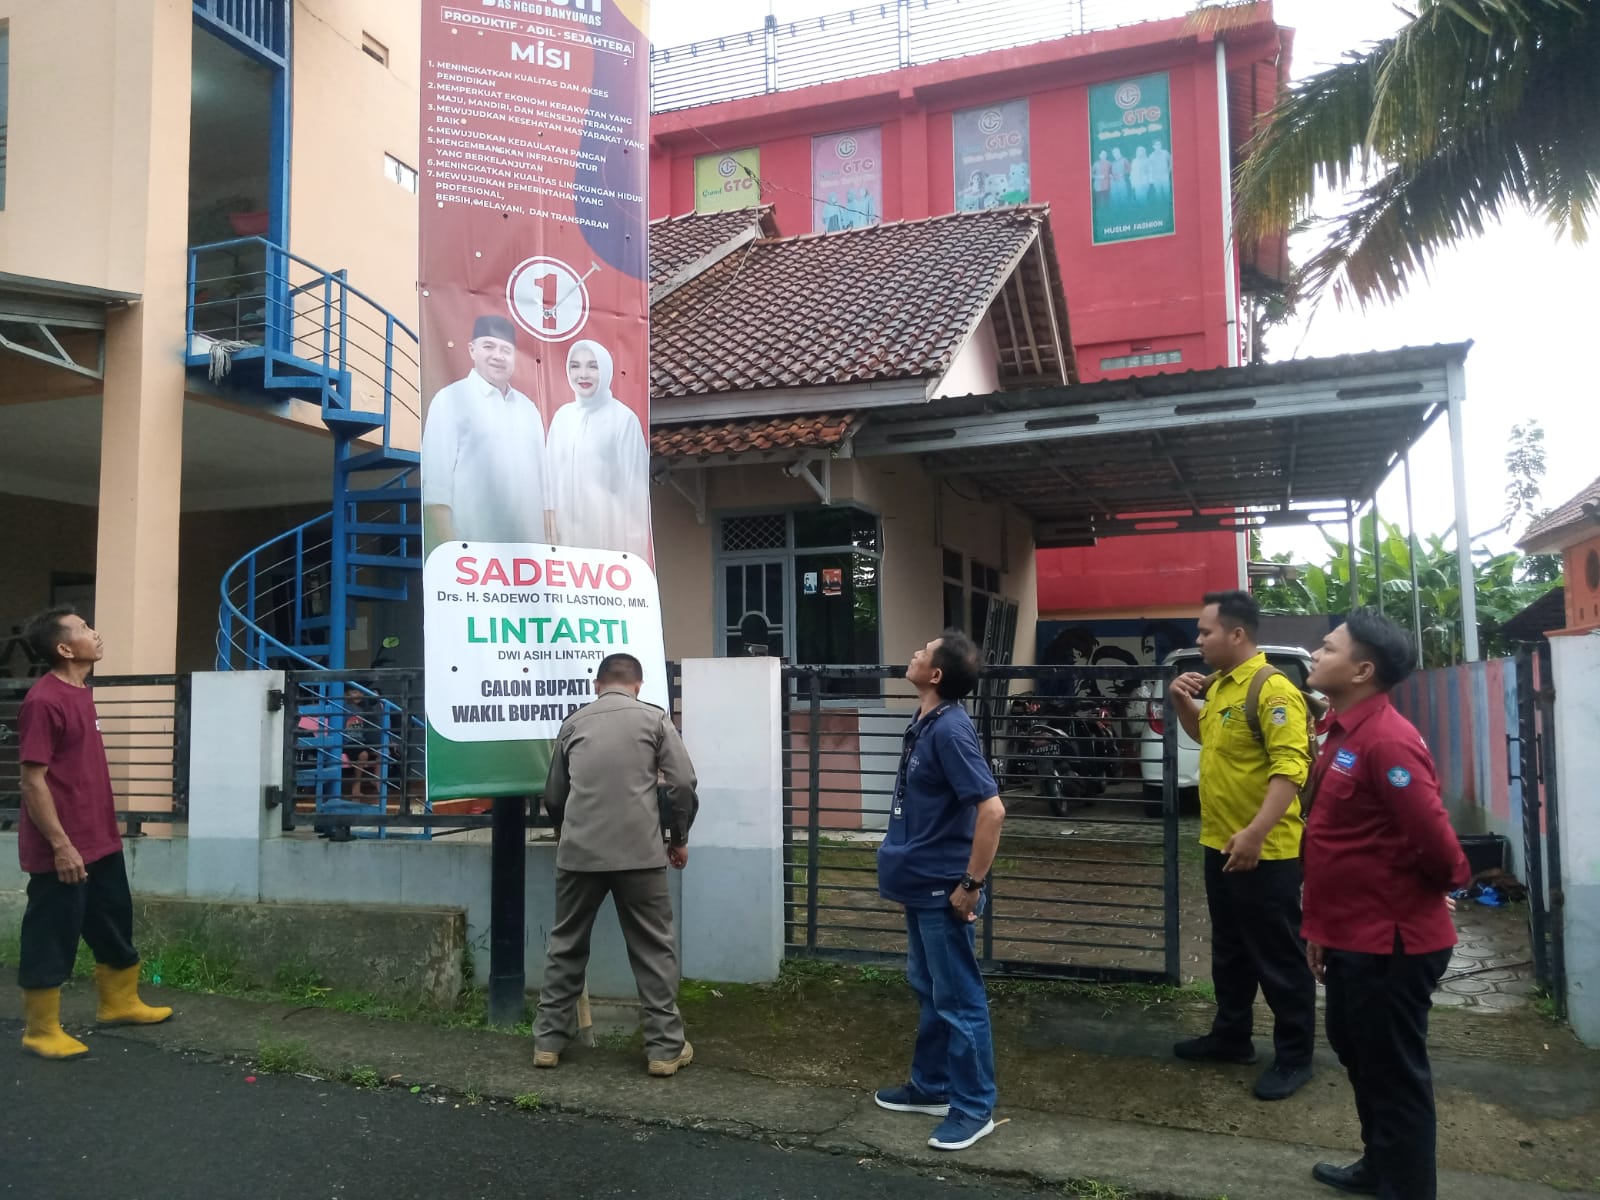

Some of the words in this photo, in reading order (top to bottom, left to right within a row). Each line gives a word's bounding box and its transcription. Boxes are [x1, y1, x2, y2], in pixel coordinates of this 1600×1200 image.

[514, 2, 542, 15] NGGO
[545, 6, 602, 26] BANYUMAS
[444, 10, 518, 30] PRODUKTIF
[527, 24, 556, 38] ADIL
[563, 31, 632, 54] SEJAHTERA
[437, 72, 496, 87] PENDIDIKAN
[437, 62, 512, 79] MENINGKATKAN
[514, 73, 558, 88] KUALITAS
[560, 82, 579, 91] DAN
[581, 87, 609, 98] AKSES
[436, 83, 502, 98] MEMPERKUAT
[505, 93, 547, 107] EKONOMI
[550, 101, 607, 119] KERAKYATAN
[609, 114, 632, 125] YANG
[436, 94, 466, 105] MAJU,
[468, 98, 511, 112] MANDIRI,
[514, 105, 534, 116] DAN
[536, 110, 623, 133] MENSEJAHTERAKAN
[1123, 106, 1161, 125] GTC
[436, 115, 460, 125] BAIK
[436, 104, 506, 121] MEWUJUDKAN
[508, 115, 561, 131] KESEHATAN
[563, 126, 622, 144] MASYARAKAT
[624, 138, 645, 150] YANG
[436, 126, 506, 143] MEWUJUDKAN
[508, 137, 568, 155] KEDAULATAN
[570, 149, 606, 163] PANGAN
[987, 132, 1020, 149] GTC
[436, 138, 524, 157] MENGEMBANGKAN
[526, 151, 598, 172] INFRASTRUKTUR
[436, 148, 462, 158] YANG
[465, 152, 543, 172] BERKELANJUTAN
[843, 159, 873, 174] GTC
[435, 182, 505, 201] PROFESIONAL,
[436, 160, 511, 178] MENINGKATKAN
[513, 171, 557, 185] KUALITAS
[558, 180, 616, 197] LINGKUNGAN
[617, 191, 643, 203] HIDUP
[436, 171, 505, 188] MEWUJUDKAN
[508, 182, 578, 201] PEMERINTAHAN
[579, 195, 604, 206] YANG
[724, 178, 753, 192] GTC
[529, 208, 549, 218] DAN
[550, 212, 609, 229] TRANSPARAN
[1104, 224, 1131, 235] MUSLIM
[1133, 219, 1164, 230] FASHION
[535, 273, 557, 330] 1
[455, 556, 632, 591] SADEWO
[437, 591, 462, 602] Drs.
[466, 592, 479, 602] H.
[482, 592, 540, 603] SADEWO
[544, 593, 563, 603] TRI
[566, 594, 626, 608] LASTIONO,
[628, 598, 649, 608] MM.
[467, 616, 629, 644] LINTARTI
[498, 650, 520, 660] DWI
[523, 650, 552, 660] ASIH
[555, 650, 605, 660] LINTARTI
[481, 680, 532, 697] CALON
[535, 678, 590, 697] BUPATI
[452, 705, 506, 723] WAKIL
[509, 704, 564, 722] BUPATI
